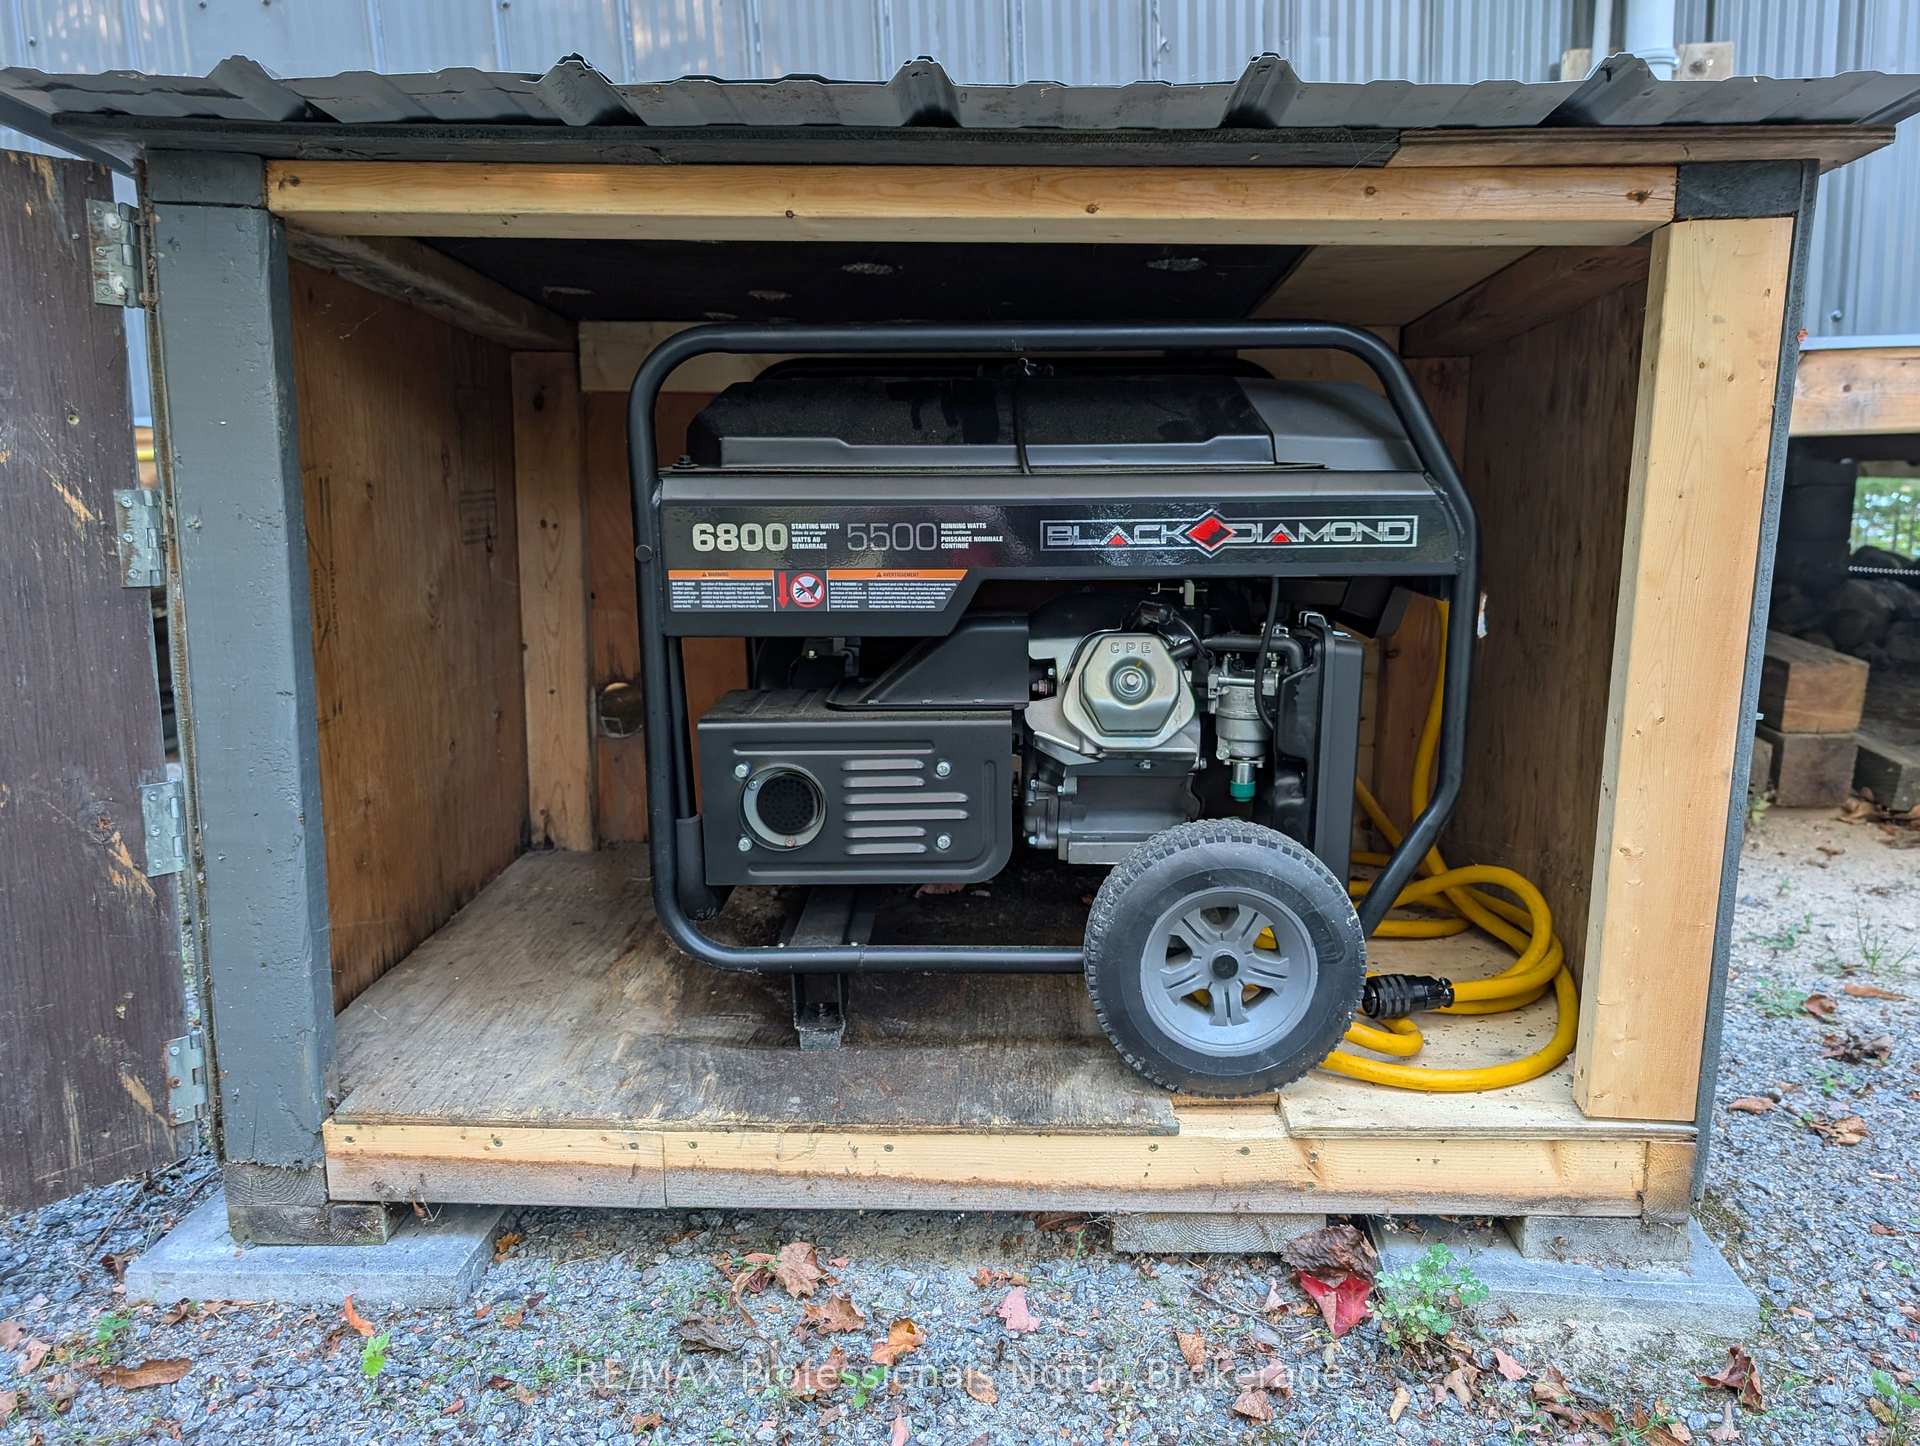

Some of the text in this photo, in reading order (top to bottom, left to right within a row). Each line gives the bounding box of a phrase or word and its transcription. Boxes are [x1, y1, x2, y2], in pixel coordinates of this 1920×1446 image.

[692, 523, 789, 551] 6800
[847, 522, 938, 551] 5500
[940, 535, 973, 543] PUISSANCE
[1046, 520, 1412, 546] BLACK DIAMOND
[1110, 641, 1152, 654] CPE
